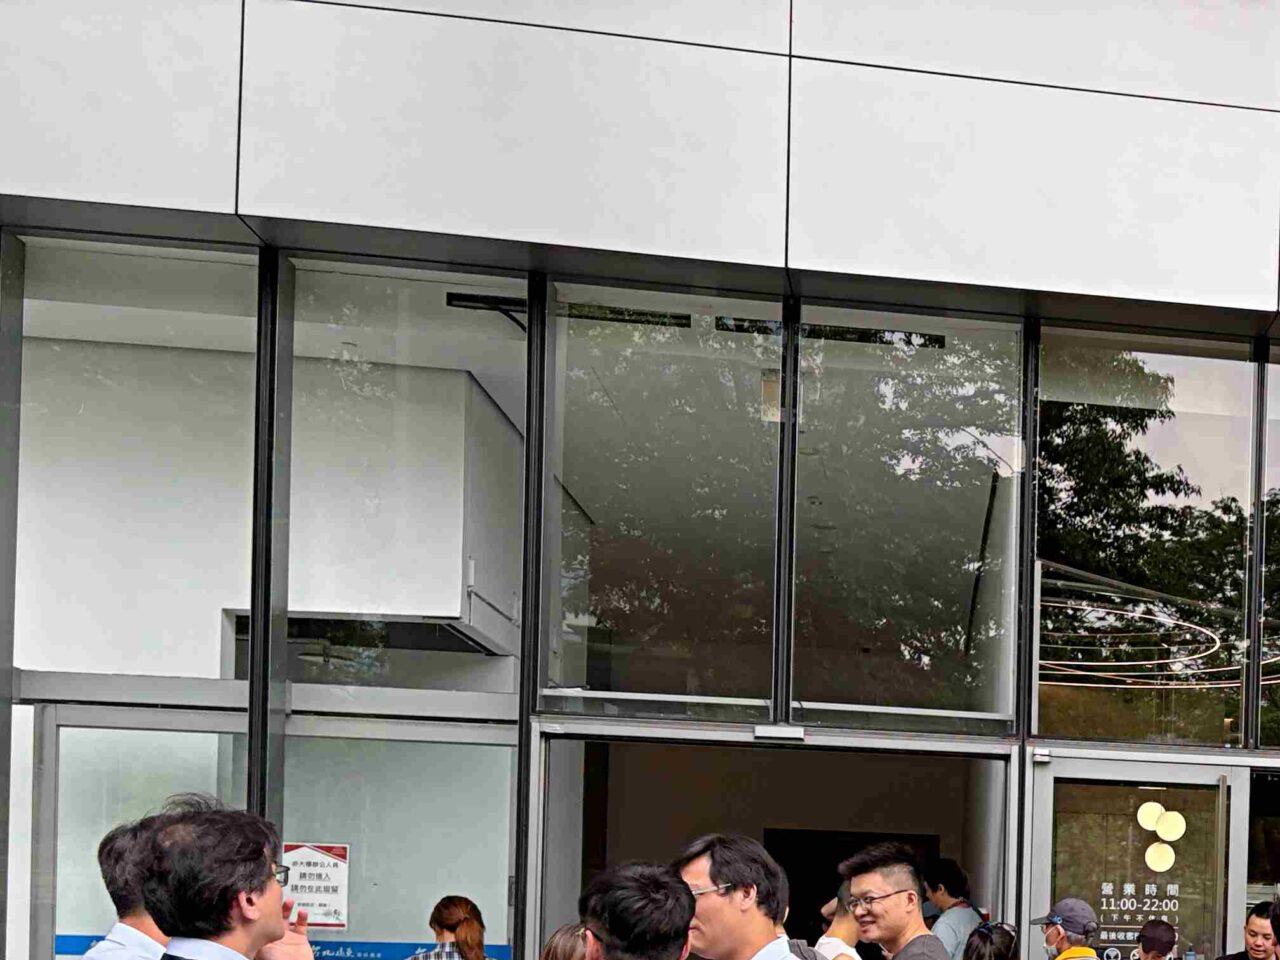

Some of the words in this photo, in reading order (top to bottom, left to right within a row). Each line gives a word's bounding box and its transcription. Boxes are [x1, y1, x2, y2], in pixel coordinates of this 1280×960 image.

[1101, 882, 1179, 897] 營業時間
[1101, 898, 1179, 912] 11:00-22:00
